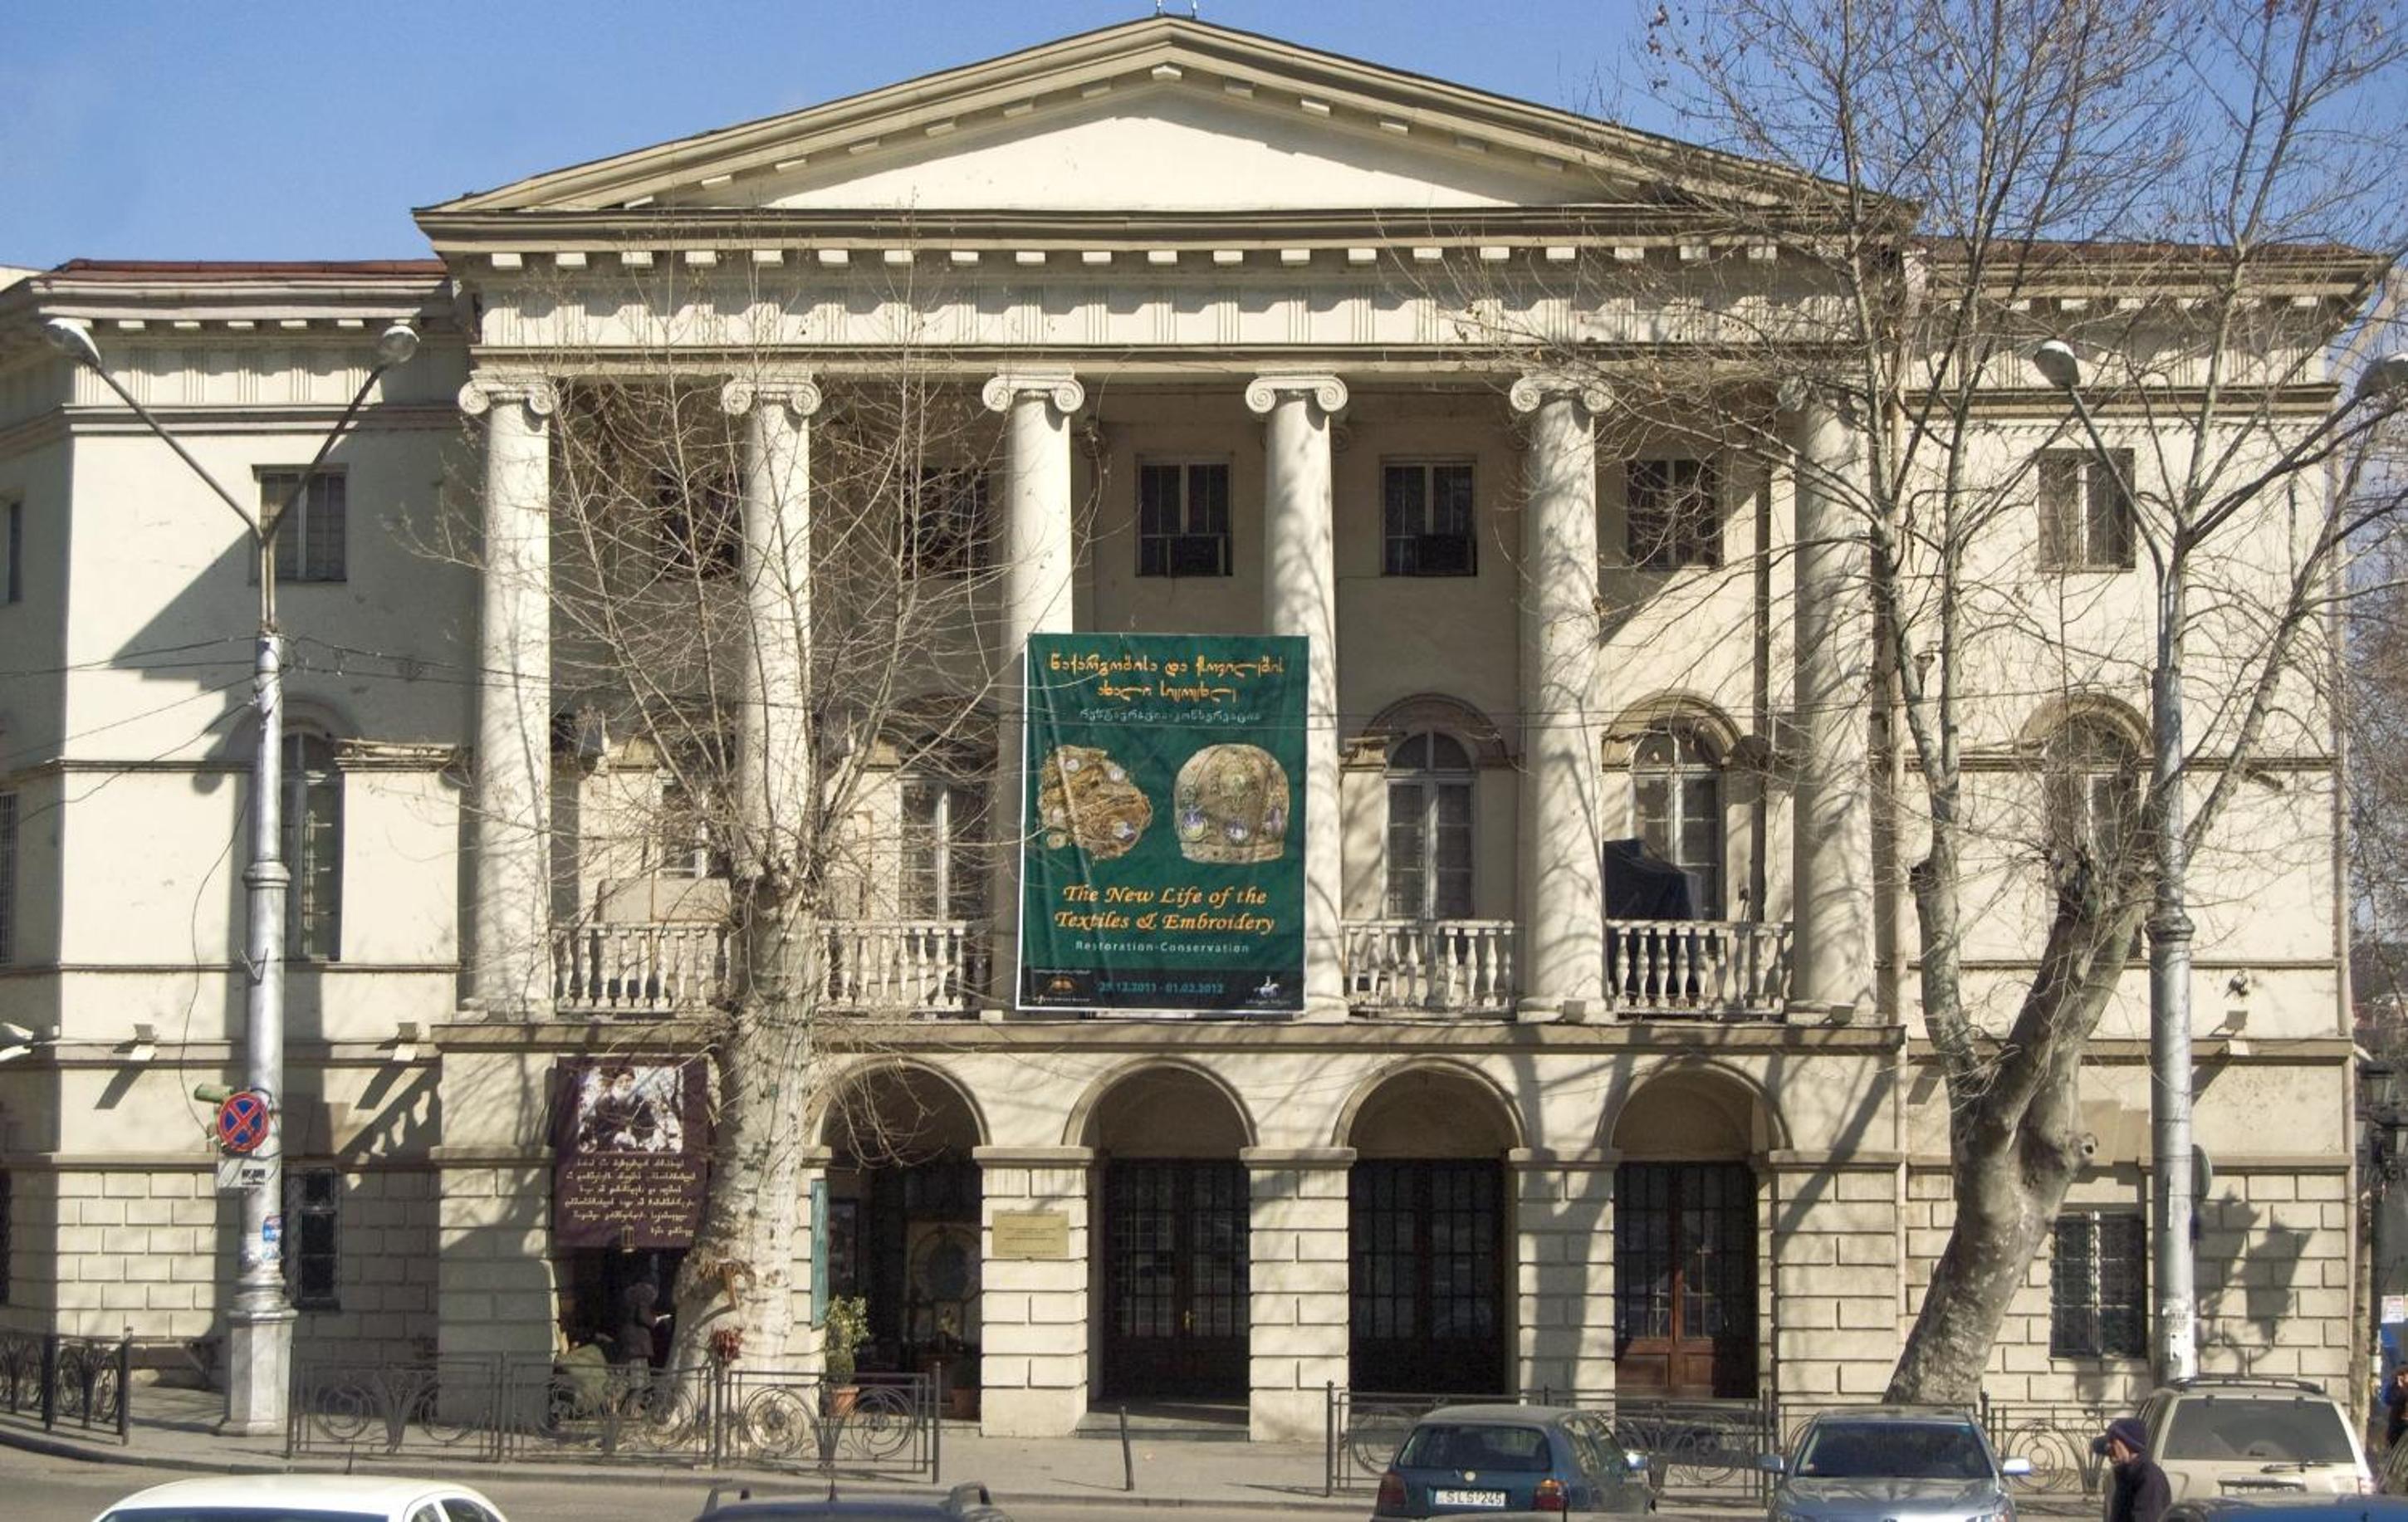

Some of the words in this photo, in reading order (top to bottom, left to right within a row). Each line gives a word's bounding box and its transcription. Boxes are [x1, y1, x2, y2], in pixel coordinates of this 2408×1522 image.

[1164, 660, 1188, 677] და
[1063, 885, 1099, 903] The
[1104, 887, 1154, 904] New
[1159, 886, 1202, 908] Life
[1208, 886, 1235, 909] of
[1236, 887, 1267, 904] the
[1055, 910, 1130, 930] Textiles
[1136, 911, 1158, 930] &
[1162, 912, 1275, 936] Embroidery
